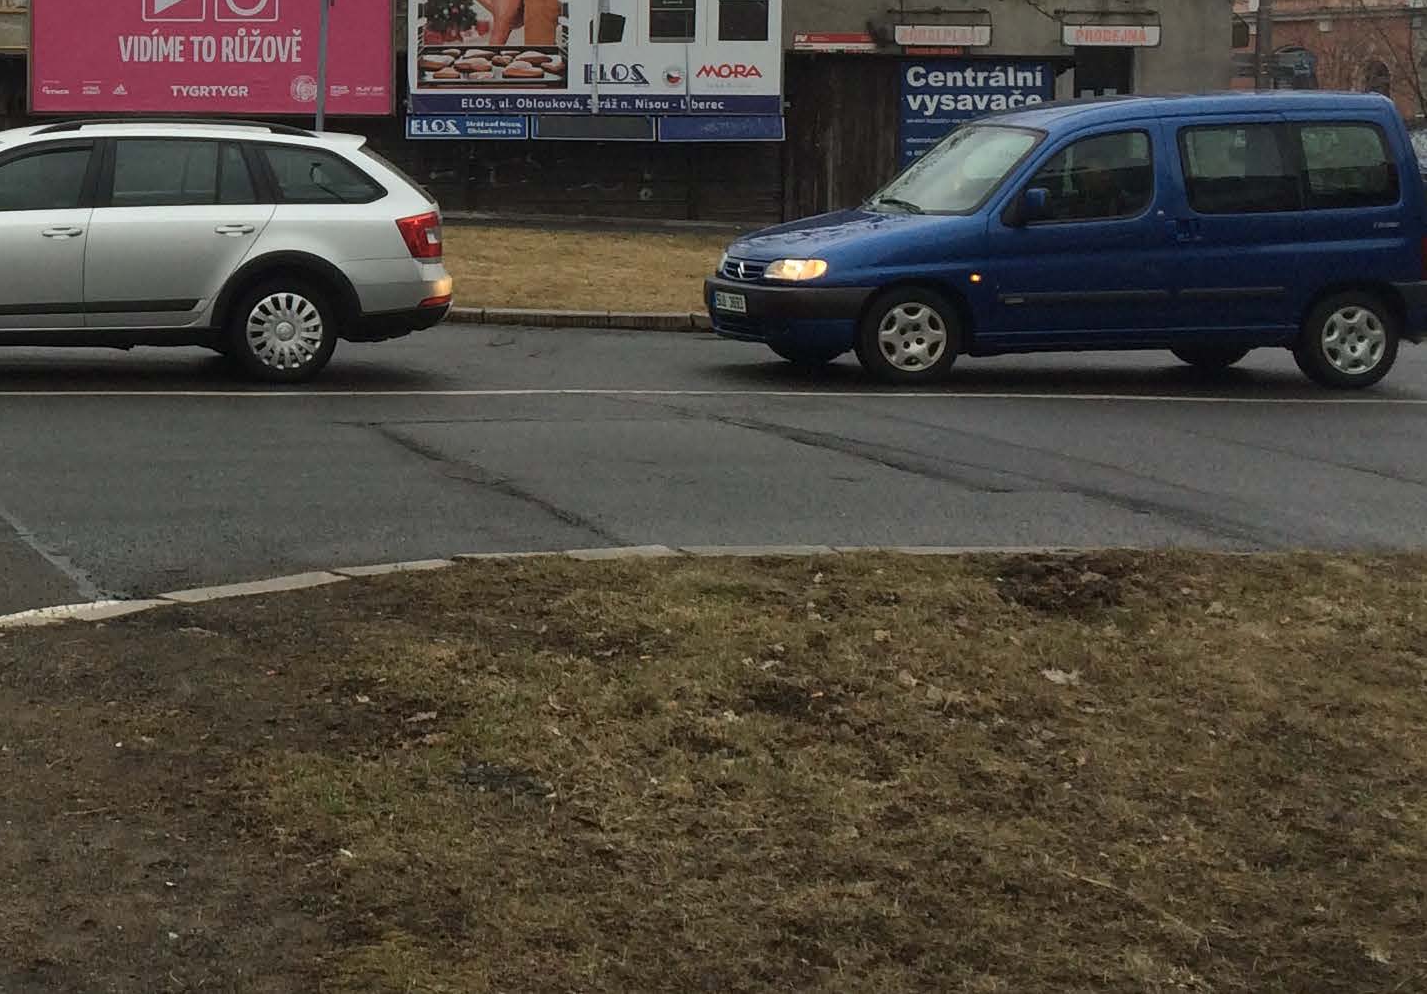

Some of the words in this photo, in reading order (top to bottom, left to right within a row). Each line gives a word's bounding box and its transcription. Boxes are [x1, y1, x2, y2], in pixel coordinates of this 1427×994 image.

[119, 28, 185, 62] VIDÍME
[190, 36, 216, 62] TO
[221, 28, 302, 62] RŮŽOVĚ
[696, 64, 763, 78] MORA
[906, 65, 1044, 87] Centrální
[171, 86, 249, 97] TYGRTYGR
[461, 99, 495, 110] ELOS,
[516, 98, 584, 110] Oblouková,
[587, 99, 617, 109] Sráž
[635, 99, 669, 110] Nisou
[680, 99, 724, 110] Lberec
[906, 90, 1043, 116] vysavače
[411, 119, 461, 135] ELOS
